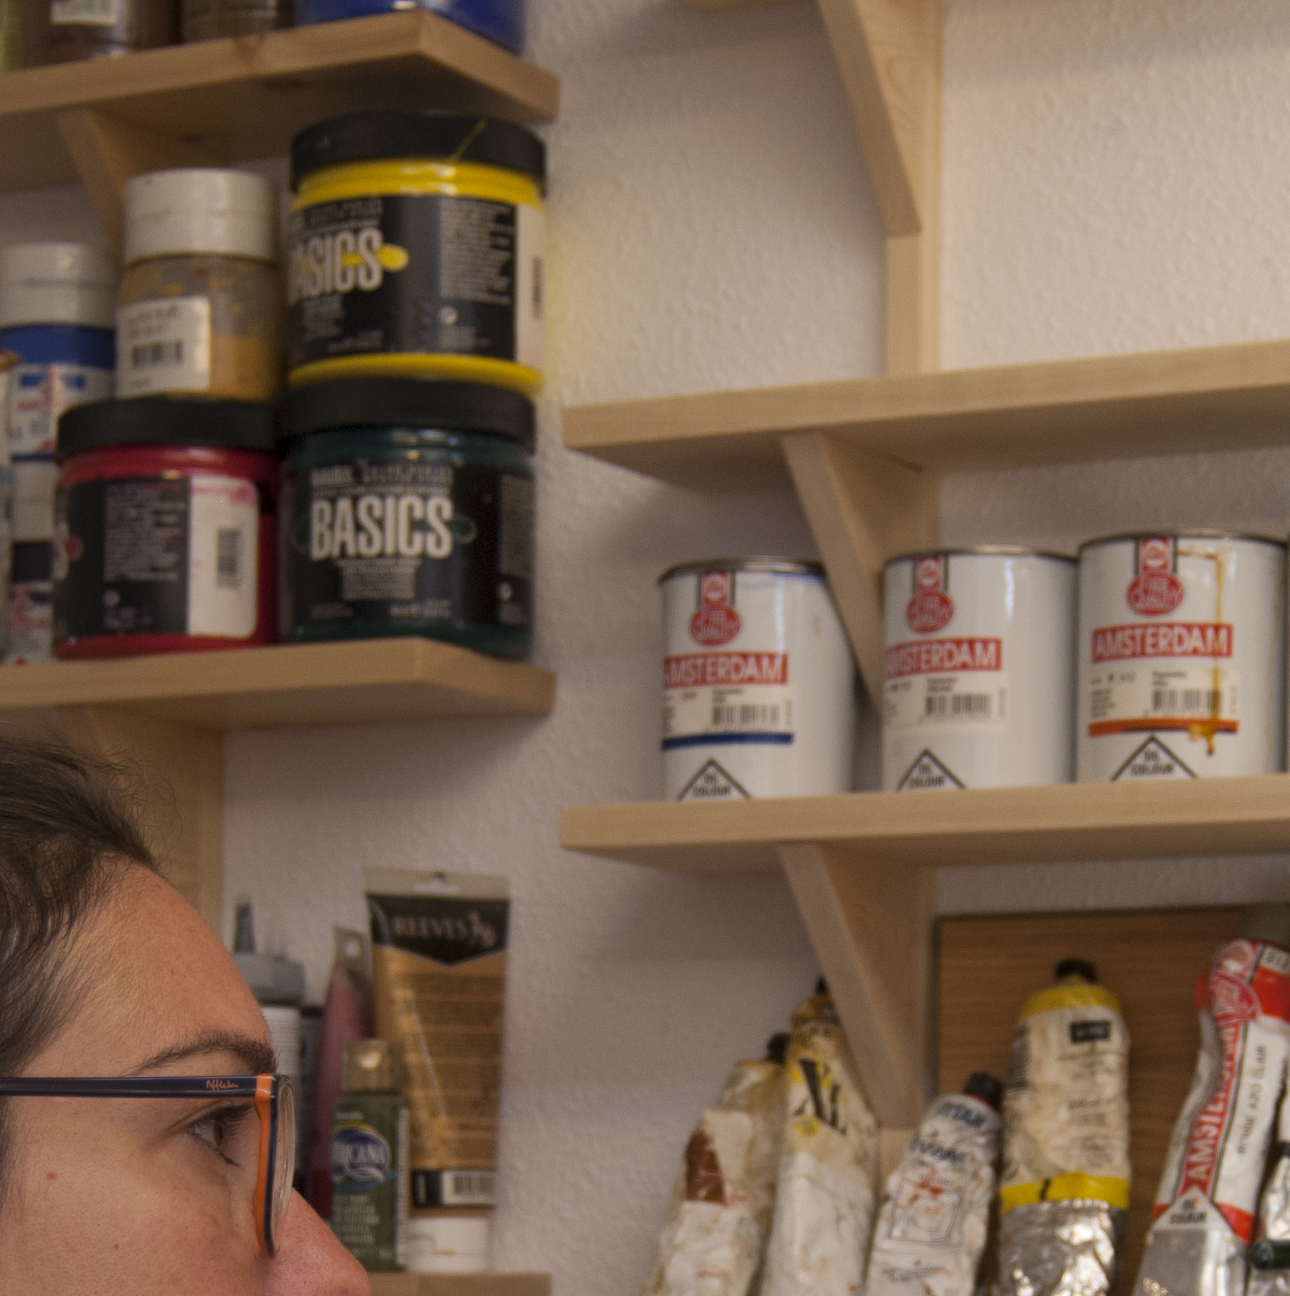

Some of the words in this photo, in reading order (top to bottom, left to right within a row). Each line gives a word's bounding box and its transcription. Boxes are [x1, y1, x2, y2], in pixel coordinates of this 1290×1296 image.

[311, 494, 453, 561] BASICS
[1095, 627, 1228, 660] AMSTERDAM
[393, 913, 468, 935] REEVES
